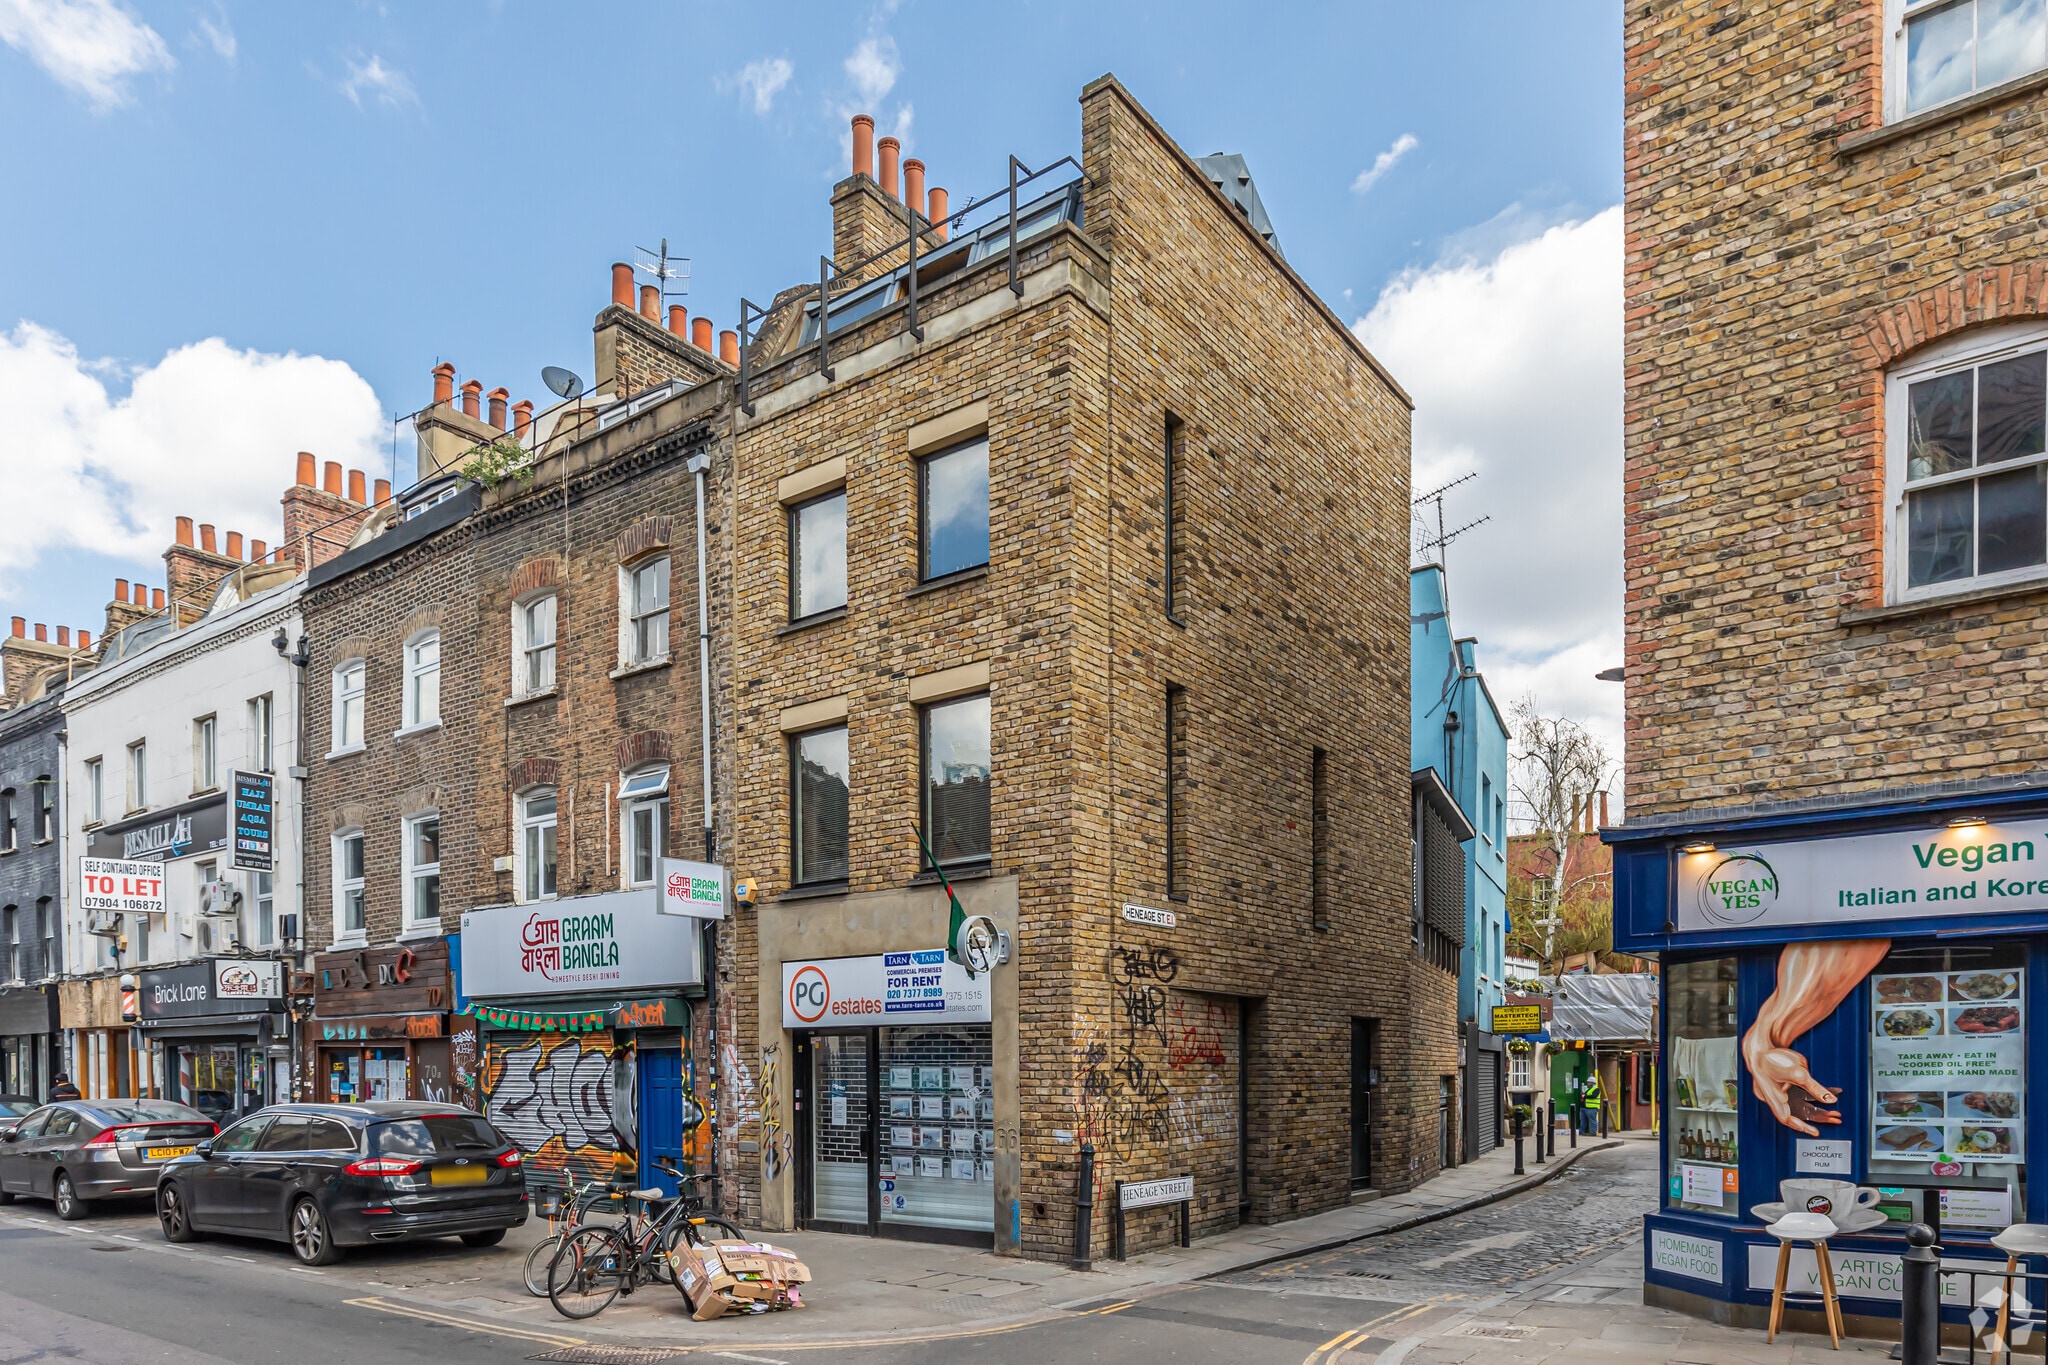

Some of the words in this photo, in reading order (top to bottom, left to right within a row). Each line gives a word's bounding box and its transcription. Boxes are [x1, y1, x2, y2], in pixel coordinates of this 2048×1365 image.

[241, 788, 265, 799] HAJJ
[236, 800, 271, 812] UMRAH
[240, 813, 266, 824] AQSA
[237, 827, 268, 838] TOURS
[1912, 840, 2034, 872] Vegan
[85, 861, 100, 872] SELF
[102, 862, 137, 875] CONTAINED
[139, 864, 161, 877] OFFICE
[85, 875, 114, 894] TO
[123, 878, 161, 897] LET
[692, 878, 719, 891] GRAAM
[1709, 877, 1773, 895] VEGAN
[692, 889, 721, 902] BANGLA
[1839, 887, 1916, 907] Italian
[1926, 881, 1976, 901] and
[85, 897, 119, 908] 07904
[123, 899, 162, 911] 106872
[1721, 894, 1760, 909] YES
[1126, 907, 1156, 921] HENEAGE
[562, 913, 614, 942] GRAAM
[563, 941, 619, 970] BANGLA
[888, 956, 907, 965] TARN
[909, 952, 918, 964] &
[920, 954, 941, 962] TARN
[378, 949, 416, 985] DOG
[887, 968, 917, 976] COMMERCIAL
[552, 974, 581, 983] HOMESTYLE
[583, 973, 599, 981] DESHI
[600, 971, 620, 980] DINING
[888, 978, 909, 988] FOR
[912, 976, 941, 986] RENT
[155, 983, 178, 1004] Brick
[180, 983, 207, 1001] Lane
[427, 987, 442, 1007] 70
[796, 982, 825, 1006] PG
[887, 990, 901, 999] 020
[903, 989, 921, 998] 7377
[923, 988, 942, 997] 8989
[965, 991, 982, 999] 1515
[832, 997, 882, 1016] estates
[887, 1001, 943, 1009] www.tarn-tarn.co.uk
[425, 1065, 441, 1079] 70a
[151, 1148, 171, 1157] LC10
[1123, 1185, 1158, 1201] HENEAGE
[1160, 1181, 1187, 1195] STREET
[1659, 1237, 1714, 1258] HOMEMADE
[1656, 1251, 1688, 1269] VEGAN
[1690, 1258, 1718, 1275] FOOD
[1807, 1272, 1871, 1289] VGAN
